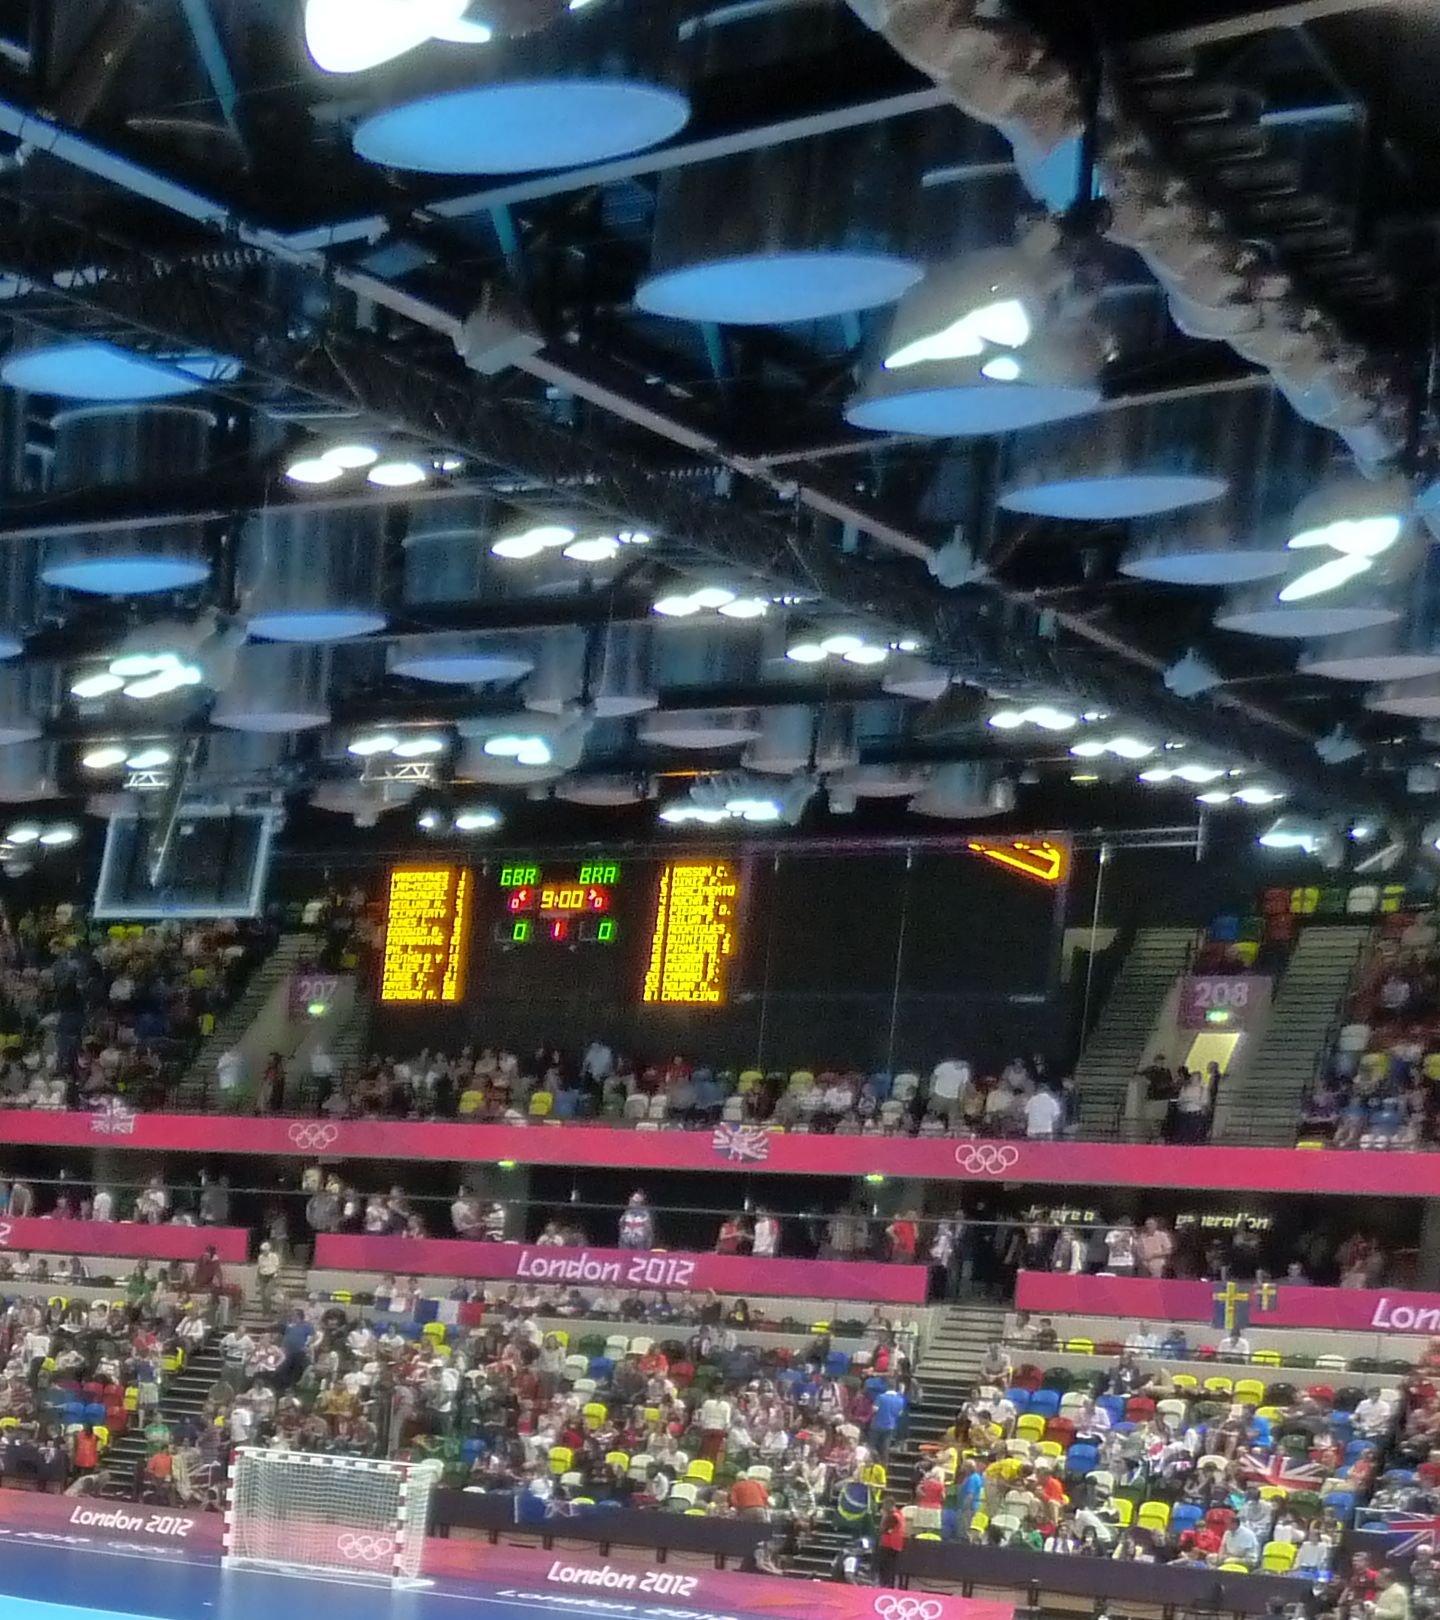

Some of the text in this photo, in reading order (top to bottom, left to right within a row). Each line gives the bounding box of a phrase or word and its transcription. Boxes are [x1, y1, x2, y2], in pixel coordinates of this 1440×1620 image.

[500, 866, 616, 886] GBR BRA
[673, 867, 712, 877] MASSON
[540, 890, 585, 909] 9:00
[671, 886, 735, 896] NASCIMENTO
[513, 923, 527, 940] 0
[598, 922, 612, 940] 0
[1193, 981, 1249, 1008] 208
[516, 1250, 696, 1287] London 2012
[1371, 1297, 1440, 1331] Lon
[69, 1505, 194, 1537] London 2012
[547, 1560, 698, 1597] London 2012
[495, 1588, 637, 1612] London
